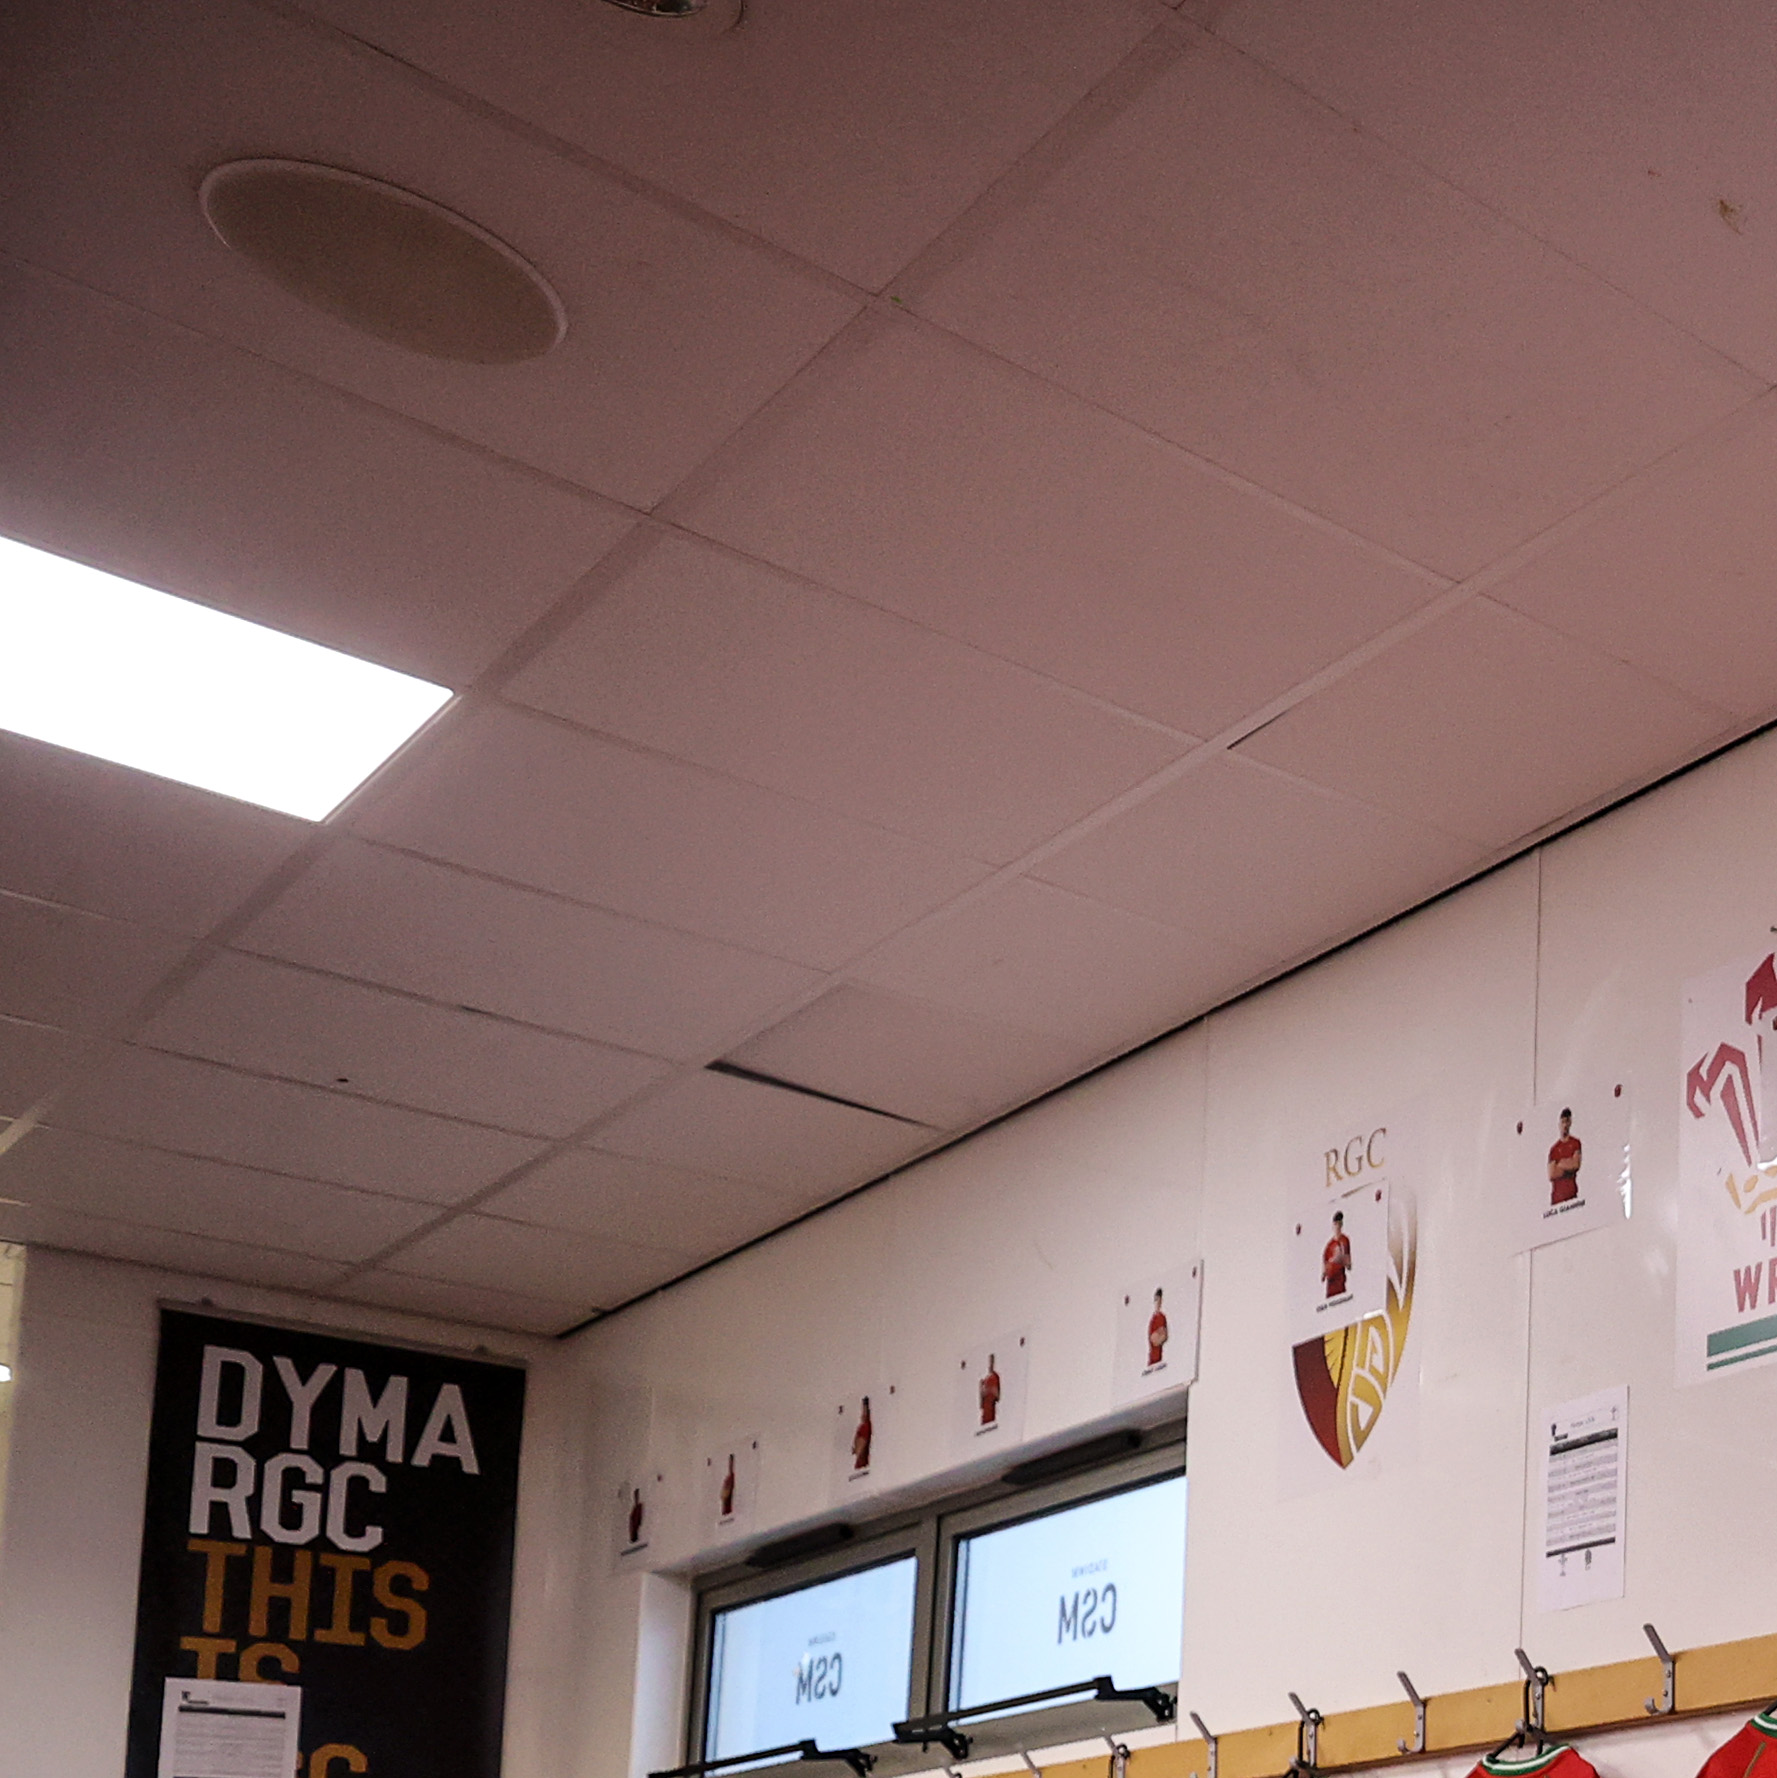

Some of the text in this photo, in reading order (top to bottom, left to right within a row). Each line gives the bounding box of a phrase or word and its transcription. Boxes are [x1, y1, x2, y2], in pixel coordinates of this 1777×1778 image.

[1323, 1127, 1387, 1188] RGC
[196, 1345, 481, 1475] DYMA
[189, 1441, 387, 1553] RGC
[187, 1539, 431, 1651] THIS
